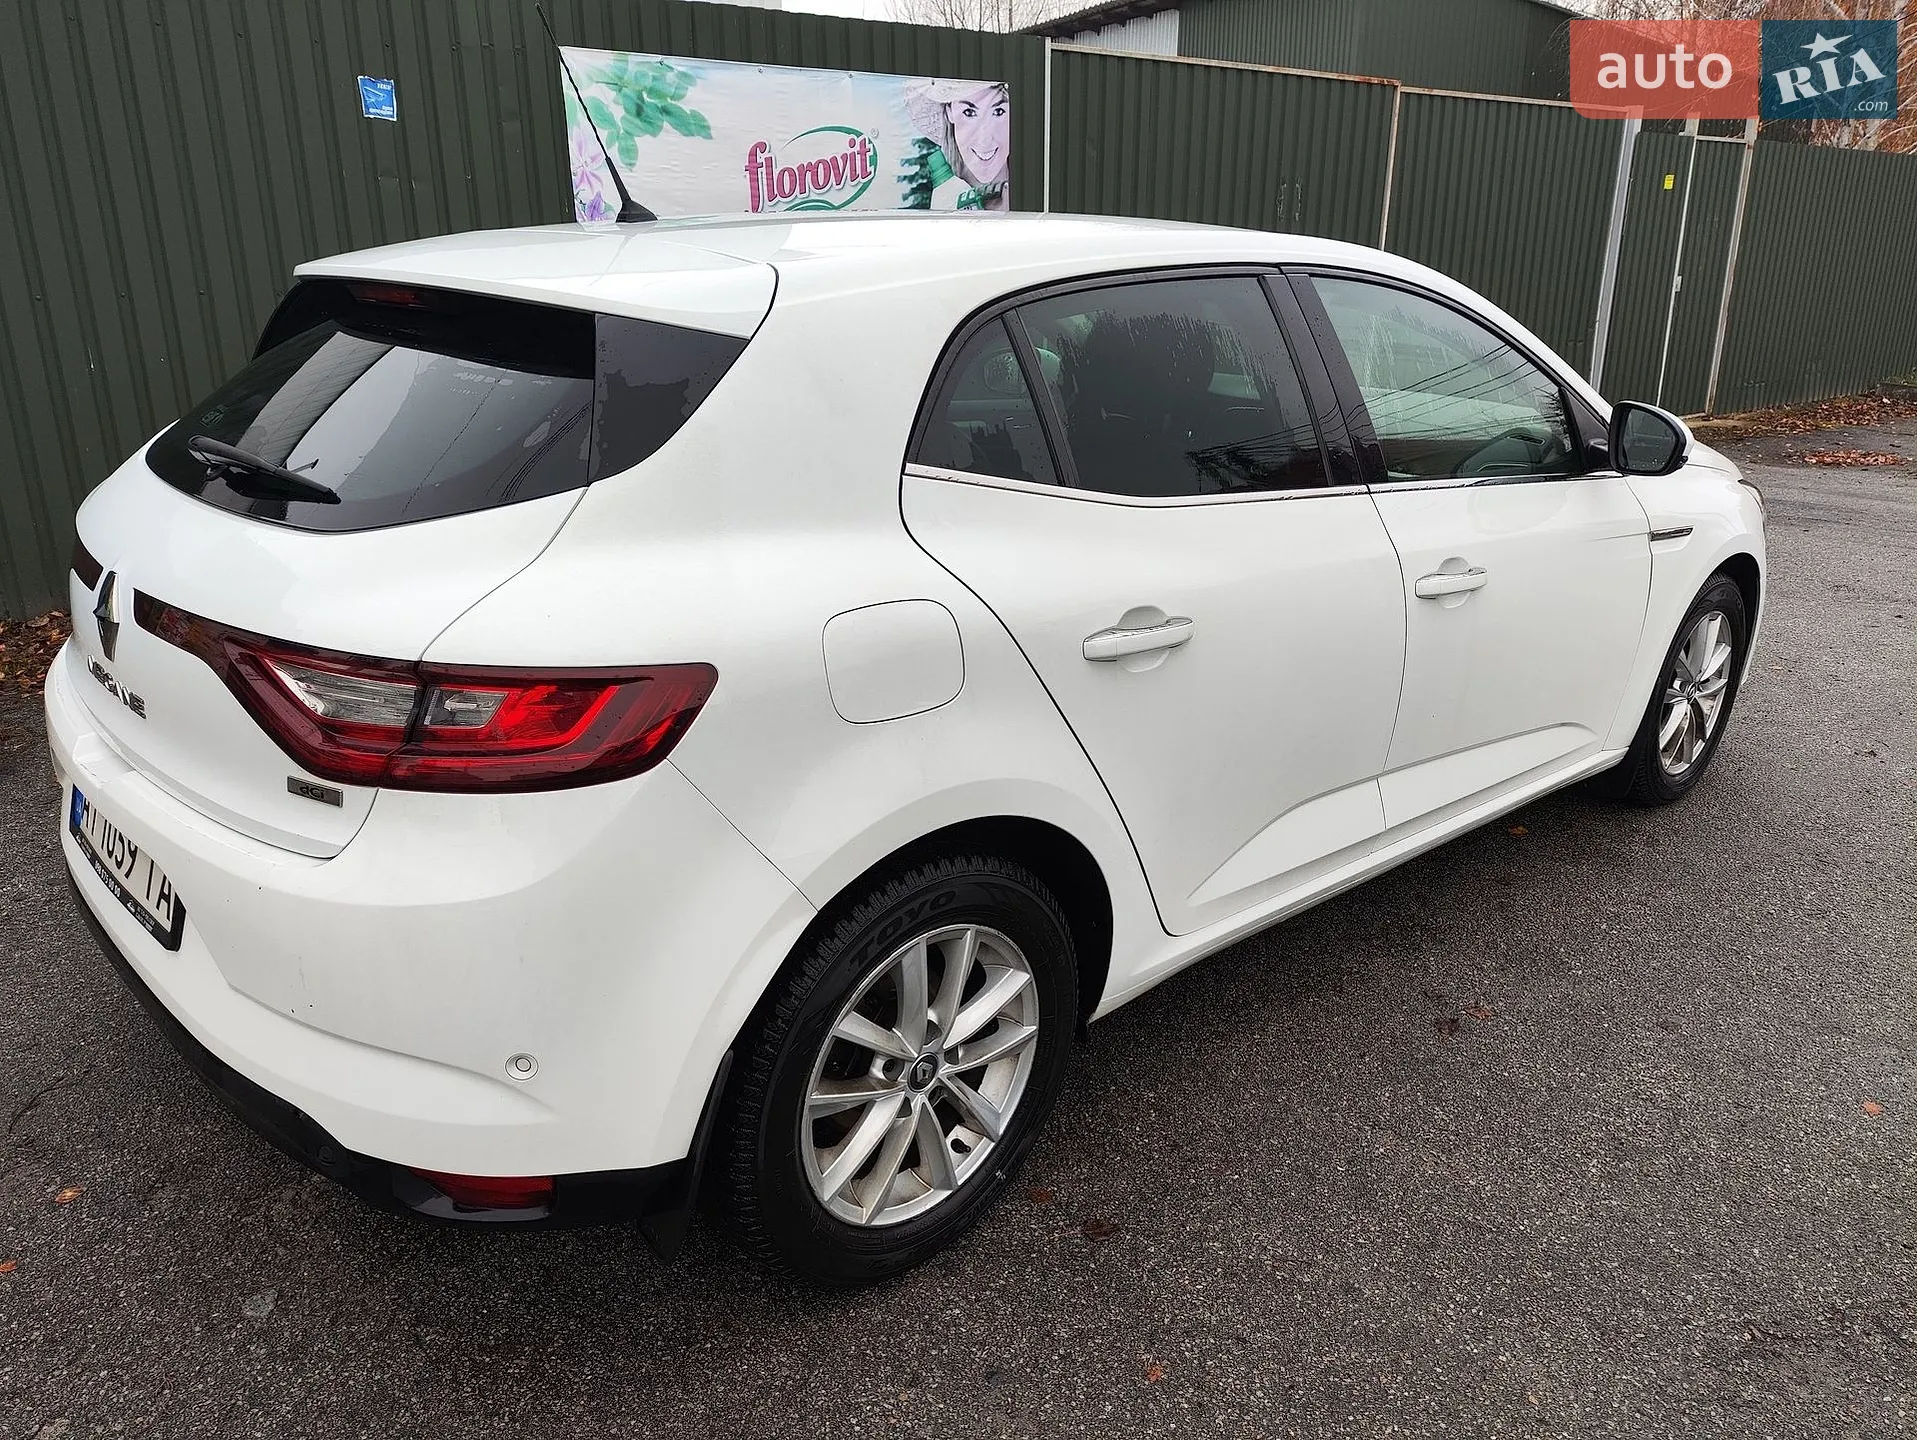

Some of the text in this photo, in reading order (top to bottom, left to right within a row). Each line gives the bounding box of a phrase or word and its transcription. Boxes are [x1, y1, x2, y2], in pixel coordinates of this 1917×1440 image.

[744, 137, 872, 213] florovit
[300, 785, 324, 799] dCi
[848, 890, 956, 970] TOYO
